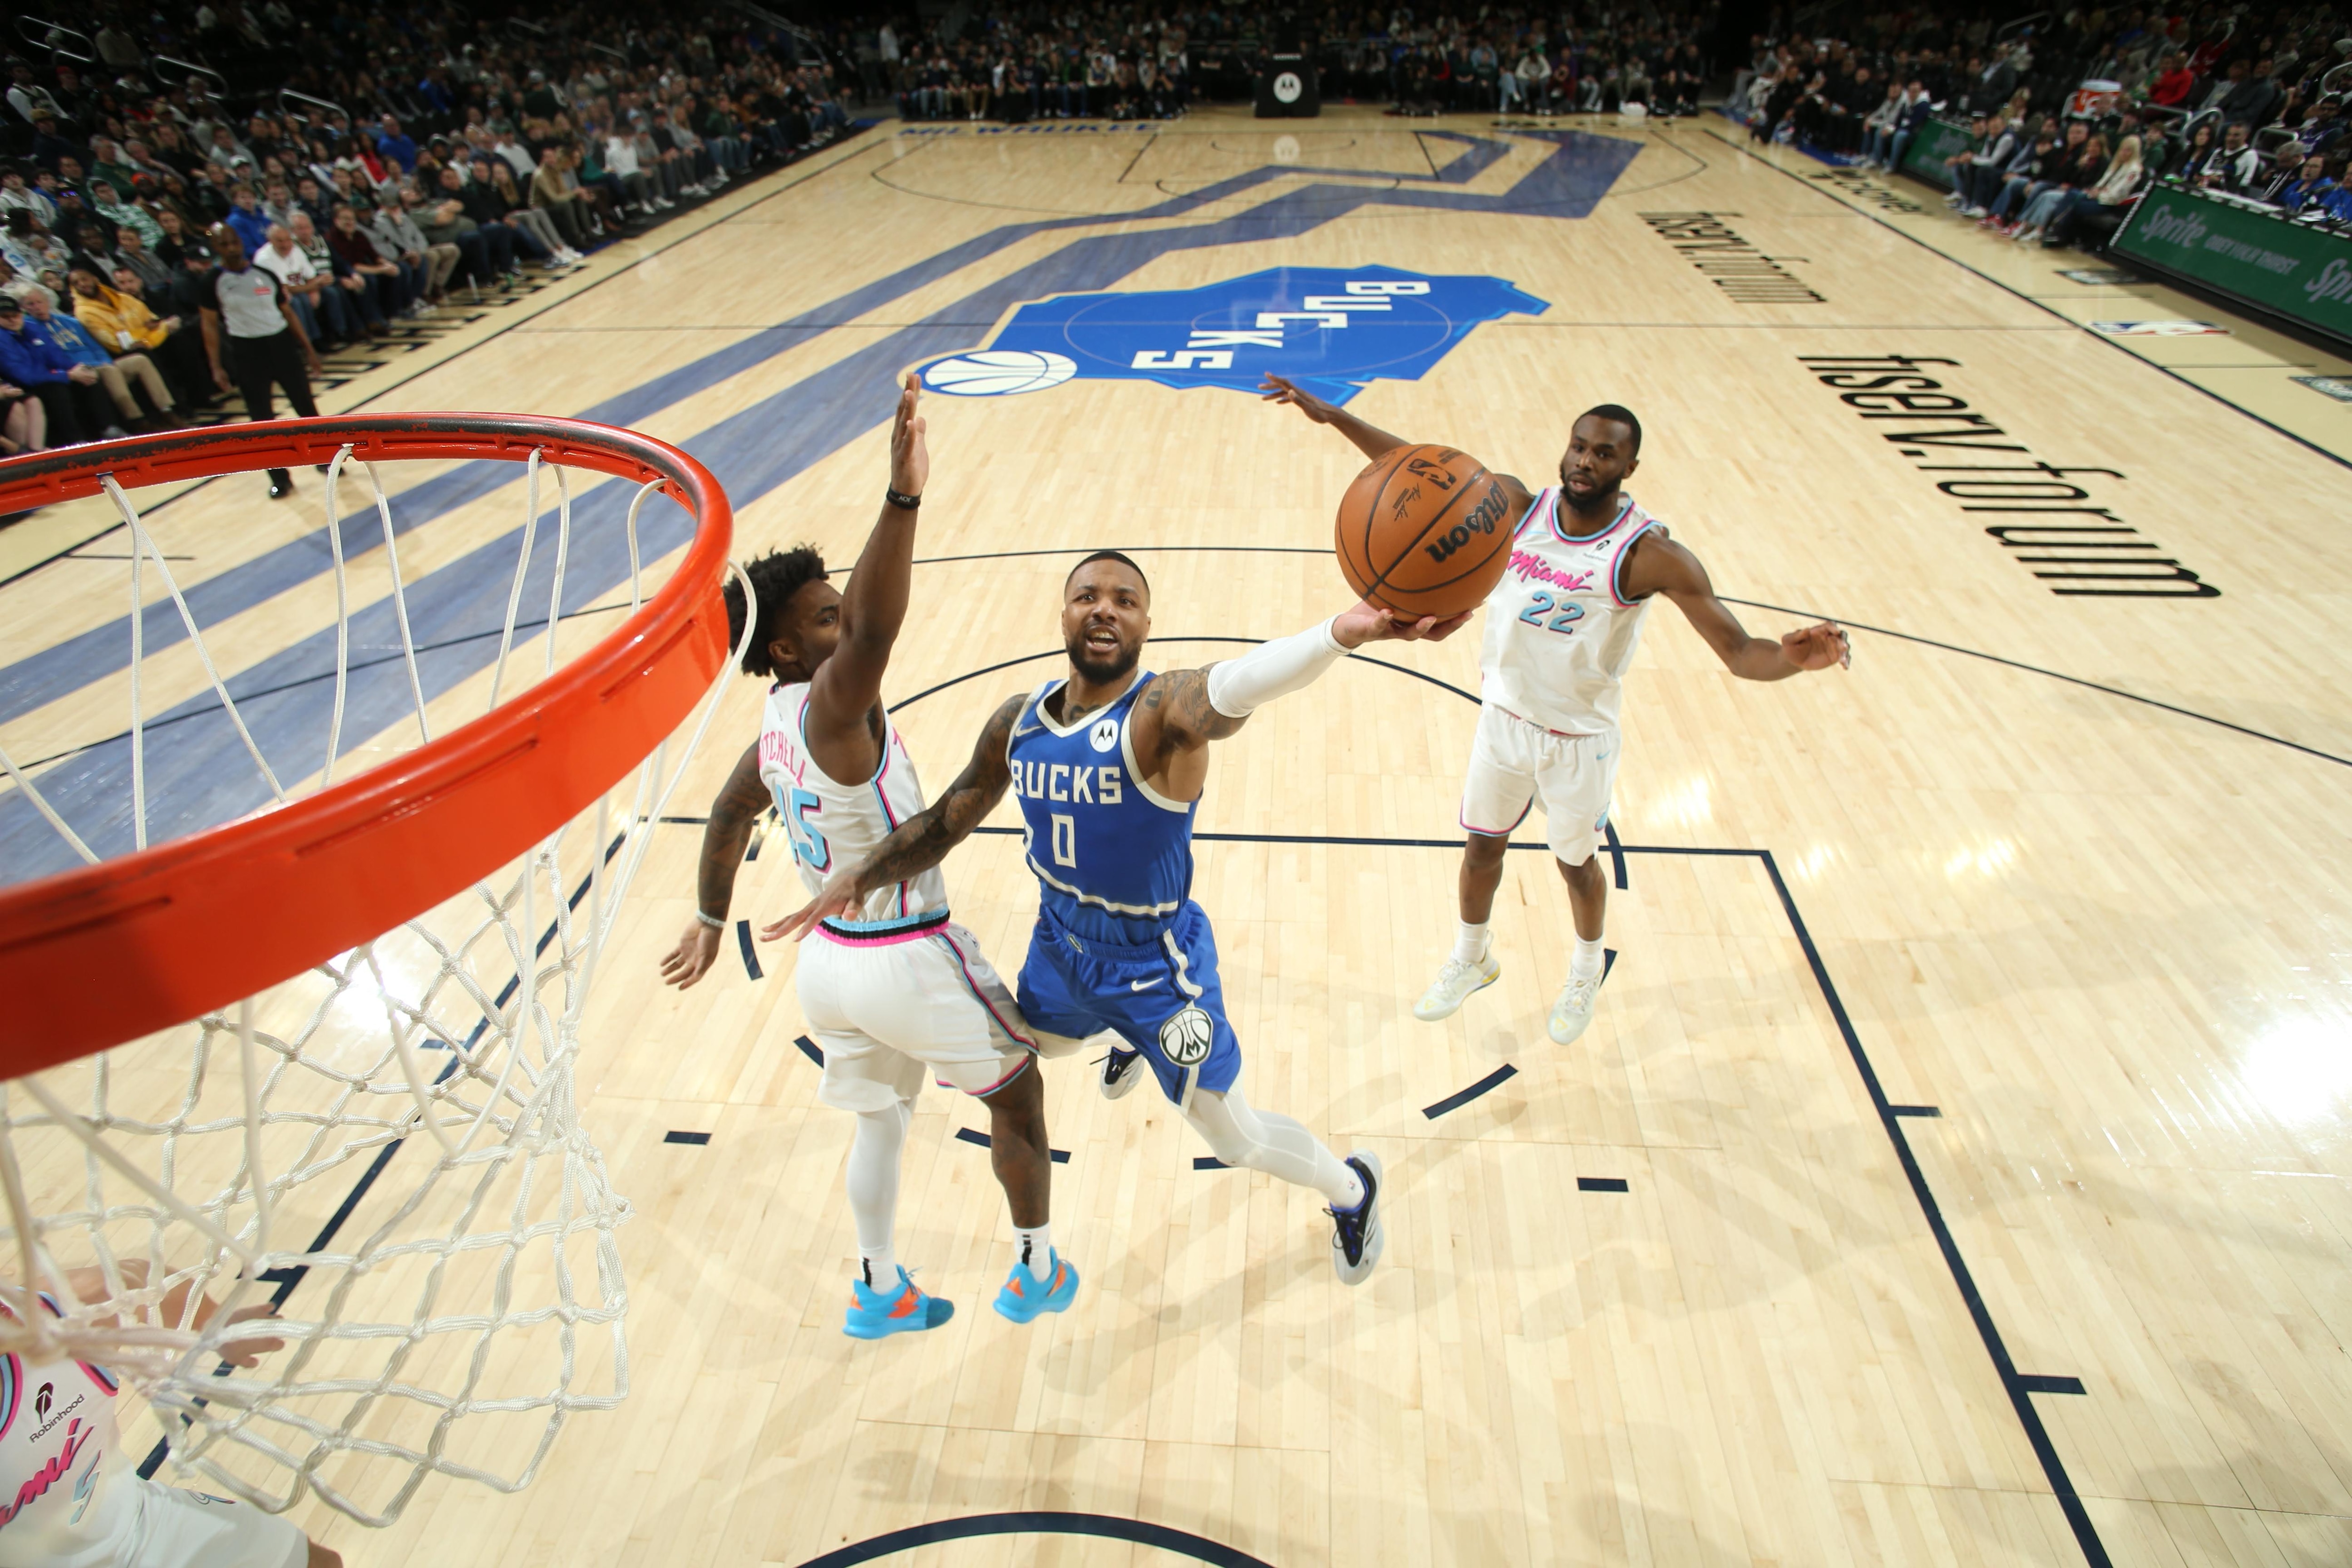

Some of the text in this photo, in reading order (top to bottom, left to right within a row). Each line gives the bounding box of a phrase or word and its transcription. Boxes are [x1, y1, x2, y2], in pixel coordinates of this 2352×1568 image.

[2139, 204, 2207, 247] Sprite
[1130, 280, 1430, 369] BUCKS
[1796, 355, 2221, 597] fiserv.forum
[1424, 480, 1509, 563] Wilson
[1507, 550, 1594, 591] Miami
[1519, 591, 1585, 635] 22
[758, 730, 806, 788] ITCHELL
[1011, 759, 1122, 804] BUCKS
[775, 784, 833, 874] 15
[1051, 813, 1077, 869] 0
[29, 1394, 85, 1443] Robinhood
